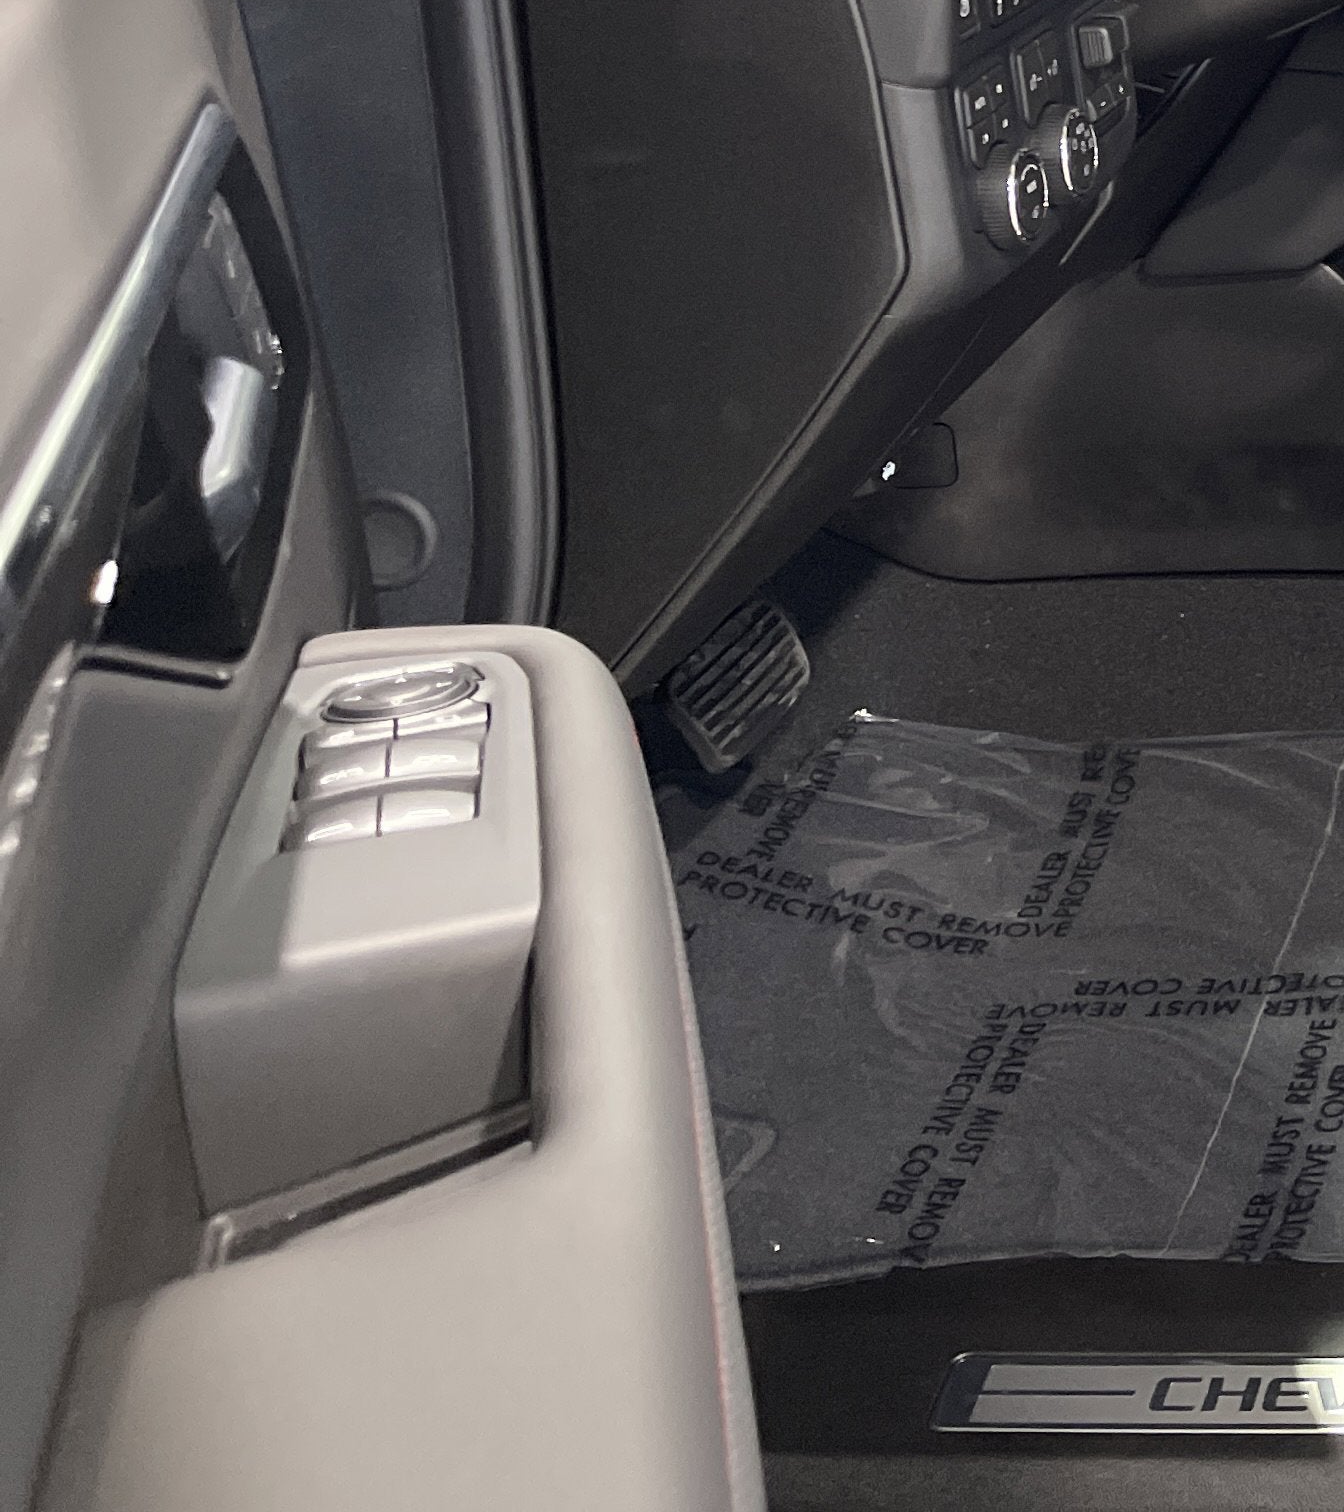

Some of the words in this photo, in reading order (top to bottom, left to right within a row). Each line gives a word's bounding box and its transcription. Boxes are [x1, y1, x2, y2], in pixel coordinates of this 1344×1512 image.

[696, 851, 814, 892] DEALER
[829, 887, 928, 921] MUST
[937, 913, 1073, 938] REMOVE
[1017, 850, 1071, 918] DEALER
[1052, 809, 1121, 917] PROTECTIVE
[677, 870, 872, 934] PROTECTIVE
[882, 926, 990, 955] COVER
[982, 1001, 1127, 1020] REMOVE
[1074, 978, 1182, 996] COVER
[1145, 998, 1241, 1017] MUST
[921, 1023, 1007, 1136] PROTECTIVE
[989, 1022, 1047, 1095] DEALER
[1262, 1116, 1304, 1176] MUST
[1284, 1019, 1337, 1105] REMOVE
[949, 1107, 1003, 1167] MUST
[875, 1144, 939, 1214] COVER
